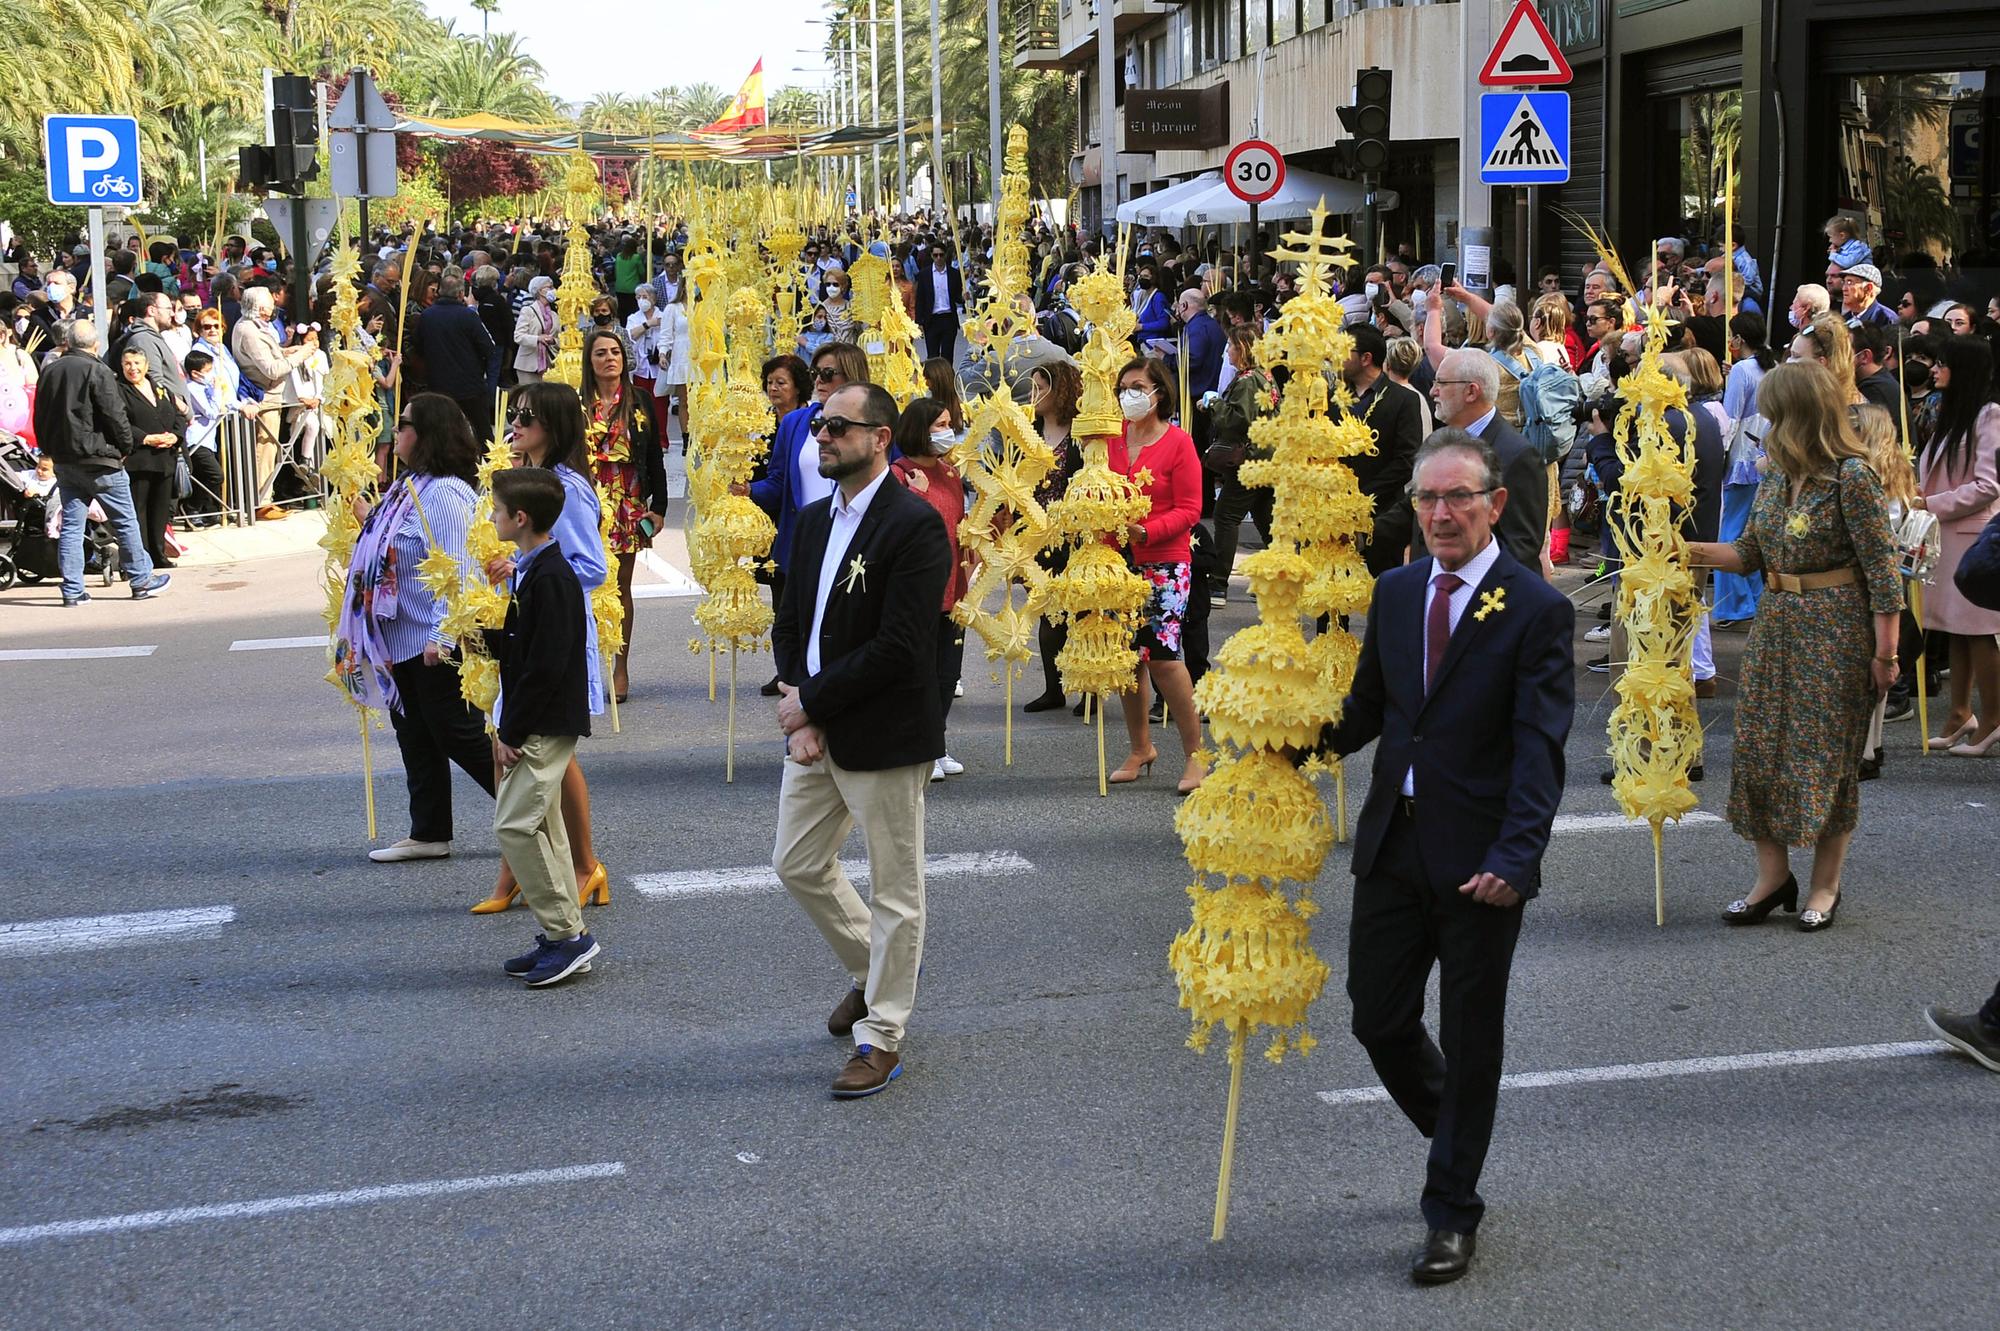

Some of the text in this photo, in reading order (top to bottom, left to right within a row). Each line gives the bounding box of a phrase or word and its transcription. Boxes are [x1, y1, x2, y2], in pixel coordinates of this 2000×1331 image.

[1131, 121, 1197, 135] El Parque
[65, 126, 120, 194] P
[1238, 161, 1271, 182] 30
